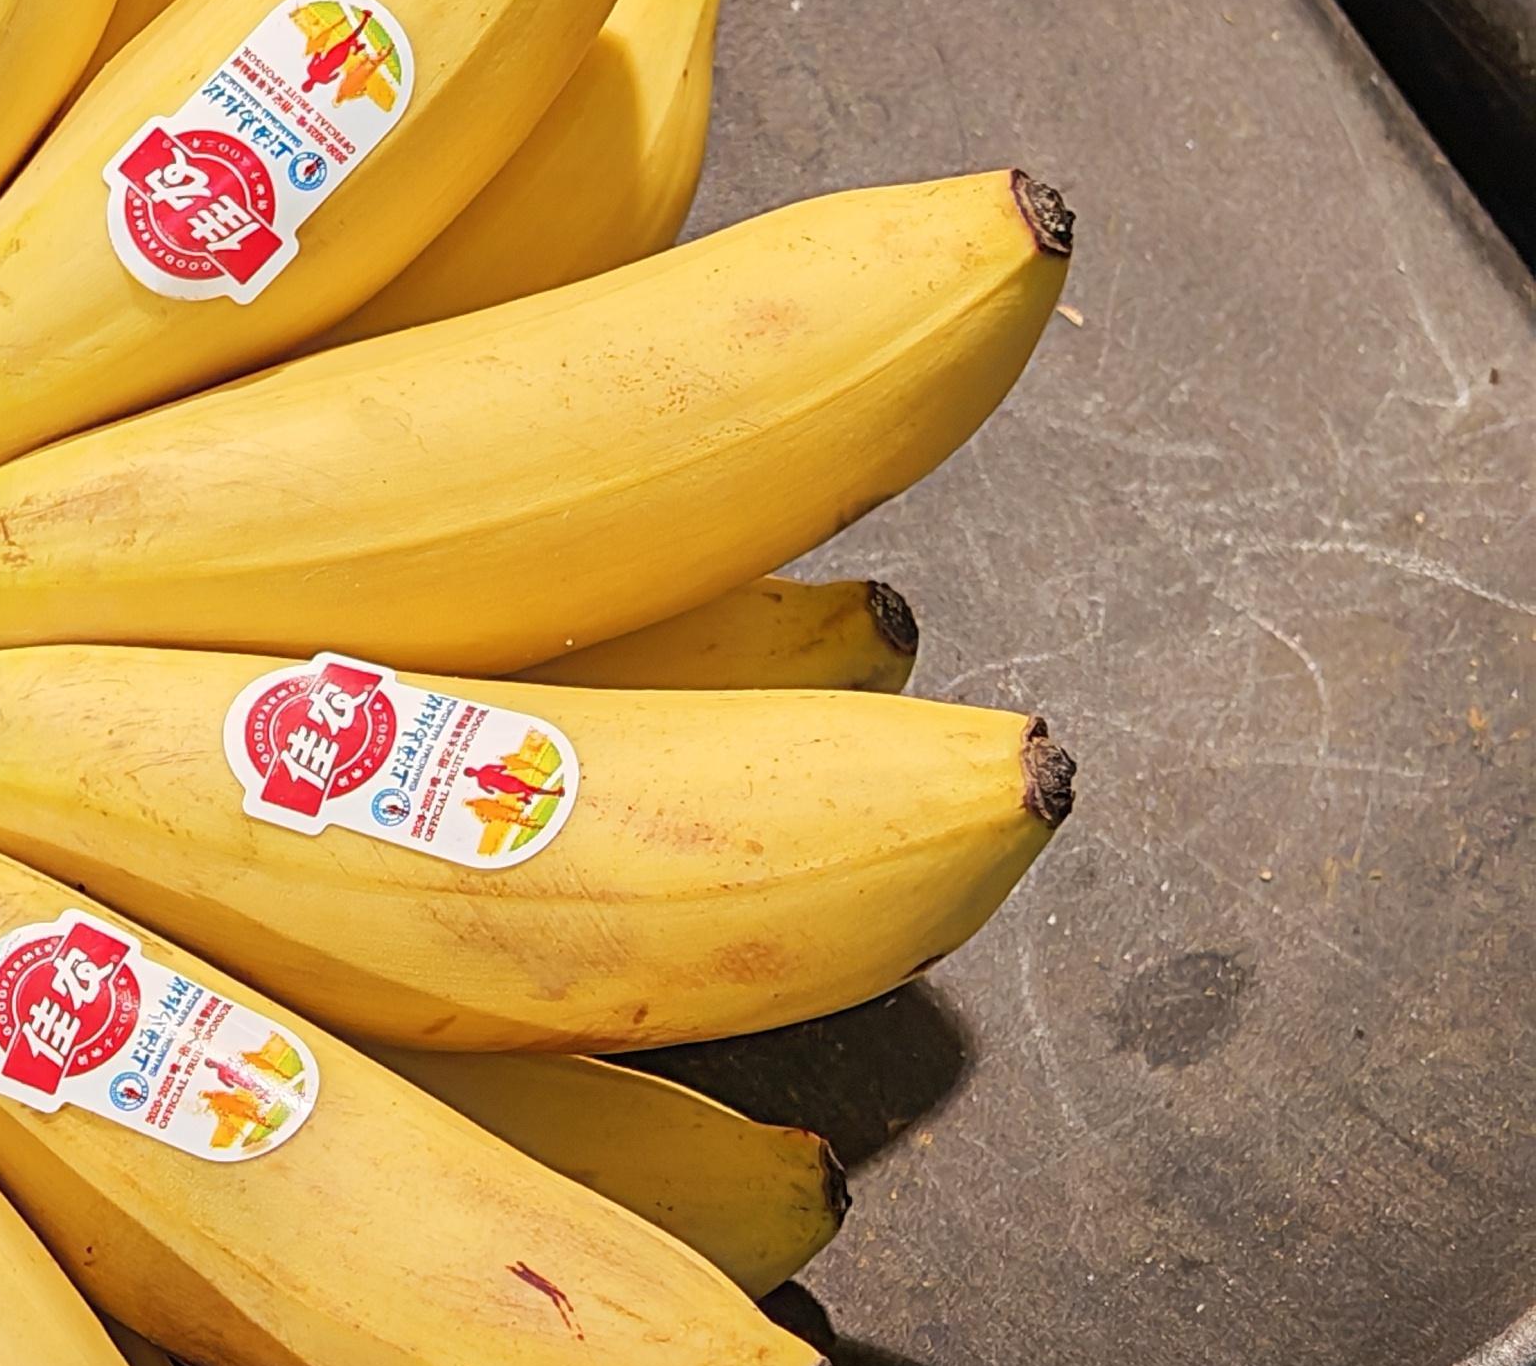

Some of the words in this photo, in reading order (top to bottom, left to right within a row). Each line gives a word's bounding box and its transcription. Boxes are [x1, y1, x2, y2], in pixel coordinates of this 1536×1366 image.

[241, 45, 286, 88] SPONSOR
[282, 83, 314, 115] FRUIT
[311, 111, 357, 155] OFFICIAL
[143, 146, 261, 253] 佳农
[279, 680, 368, 791] 佳农
[423, 787, 450, 843] OFFICIAL
[444, 752, 465, 787] FRUIT
[459, 707, 489, 753] SPONSOR
[19, 946, 114, 1067] 佳农
[156, 1075, 189, 1130] OFFICIAL
[202, 1002, 234, 1043] SPONSOR
